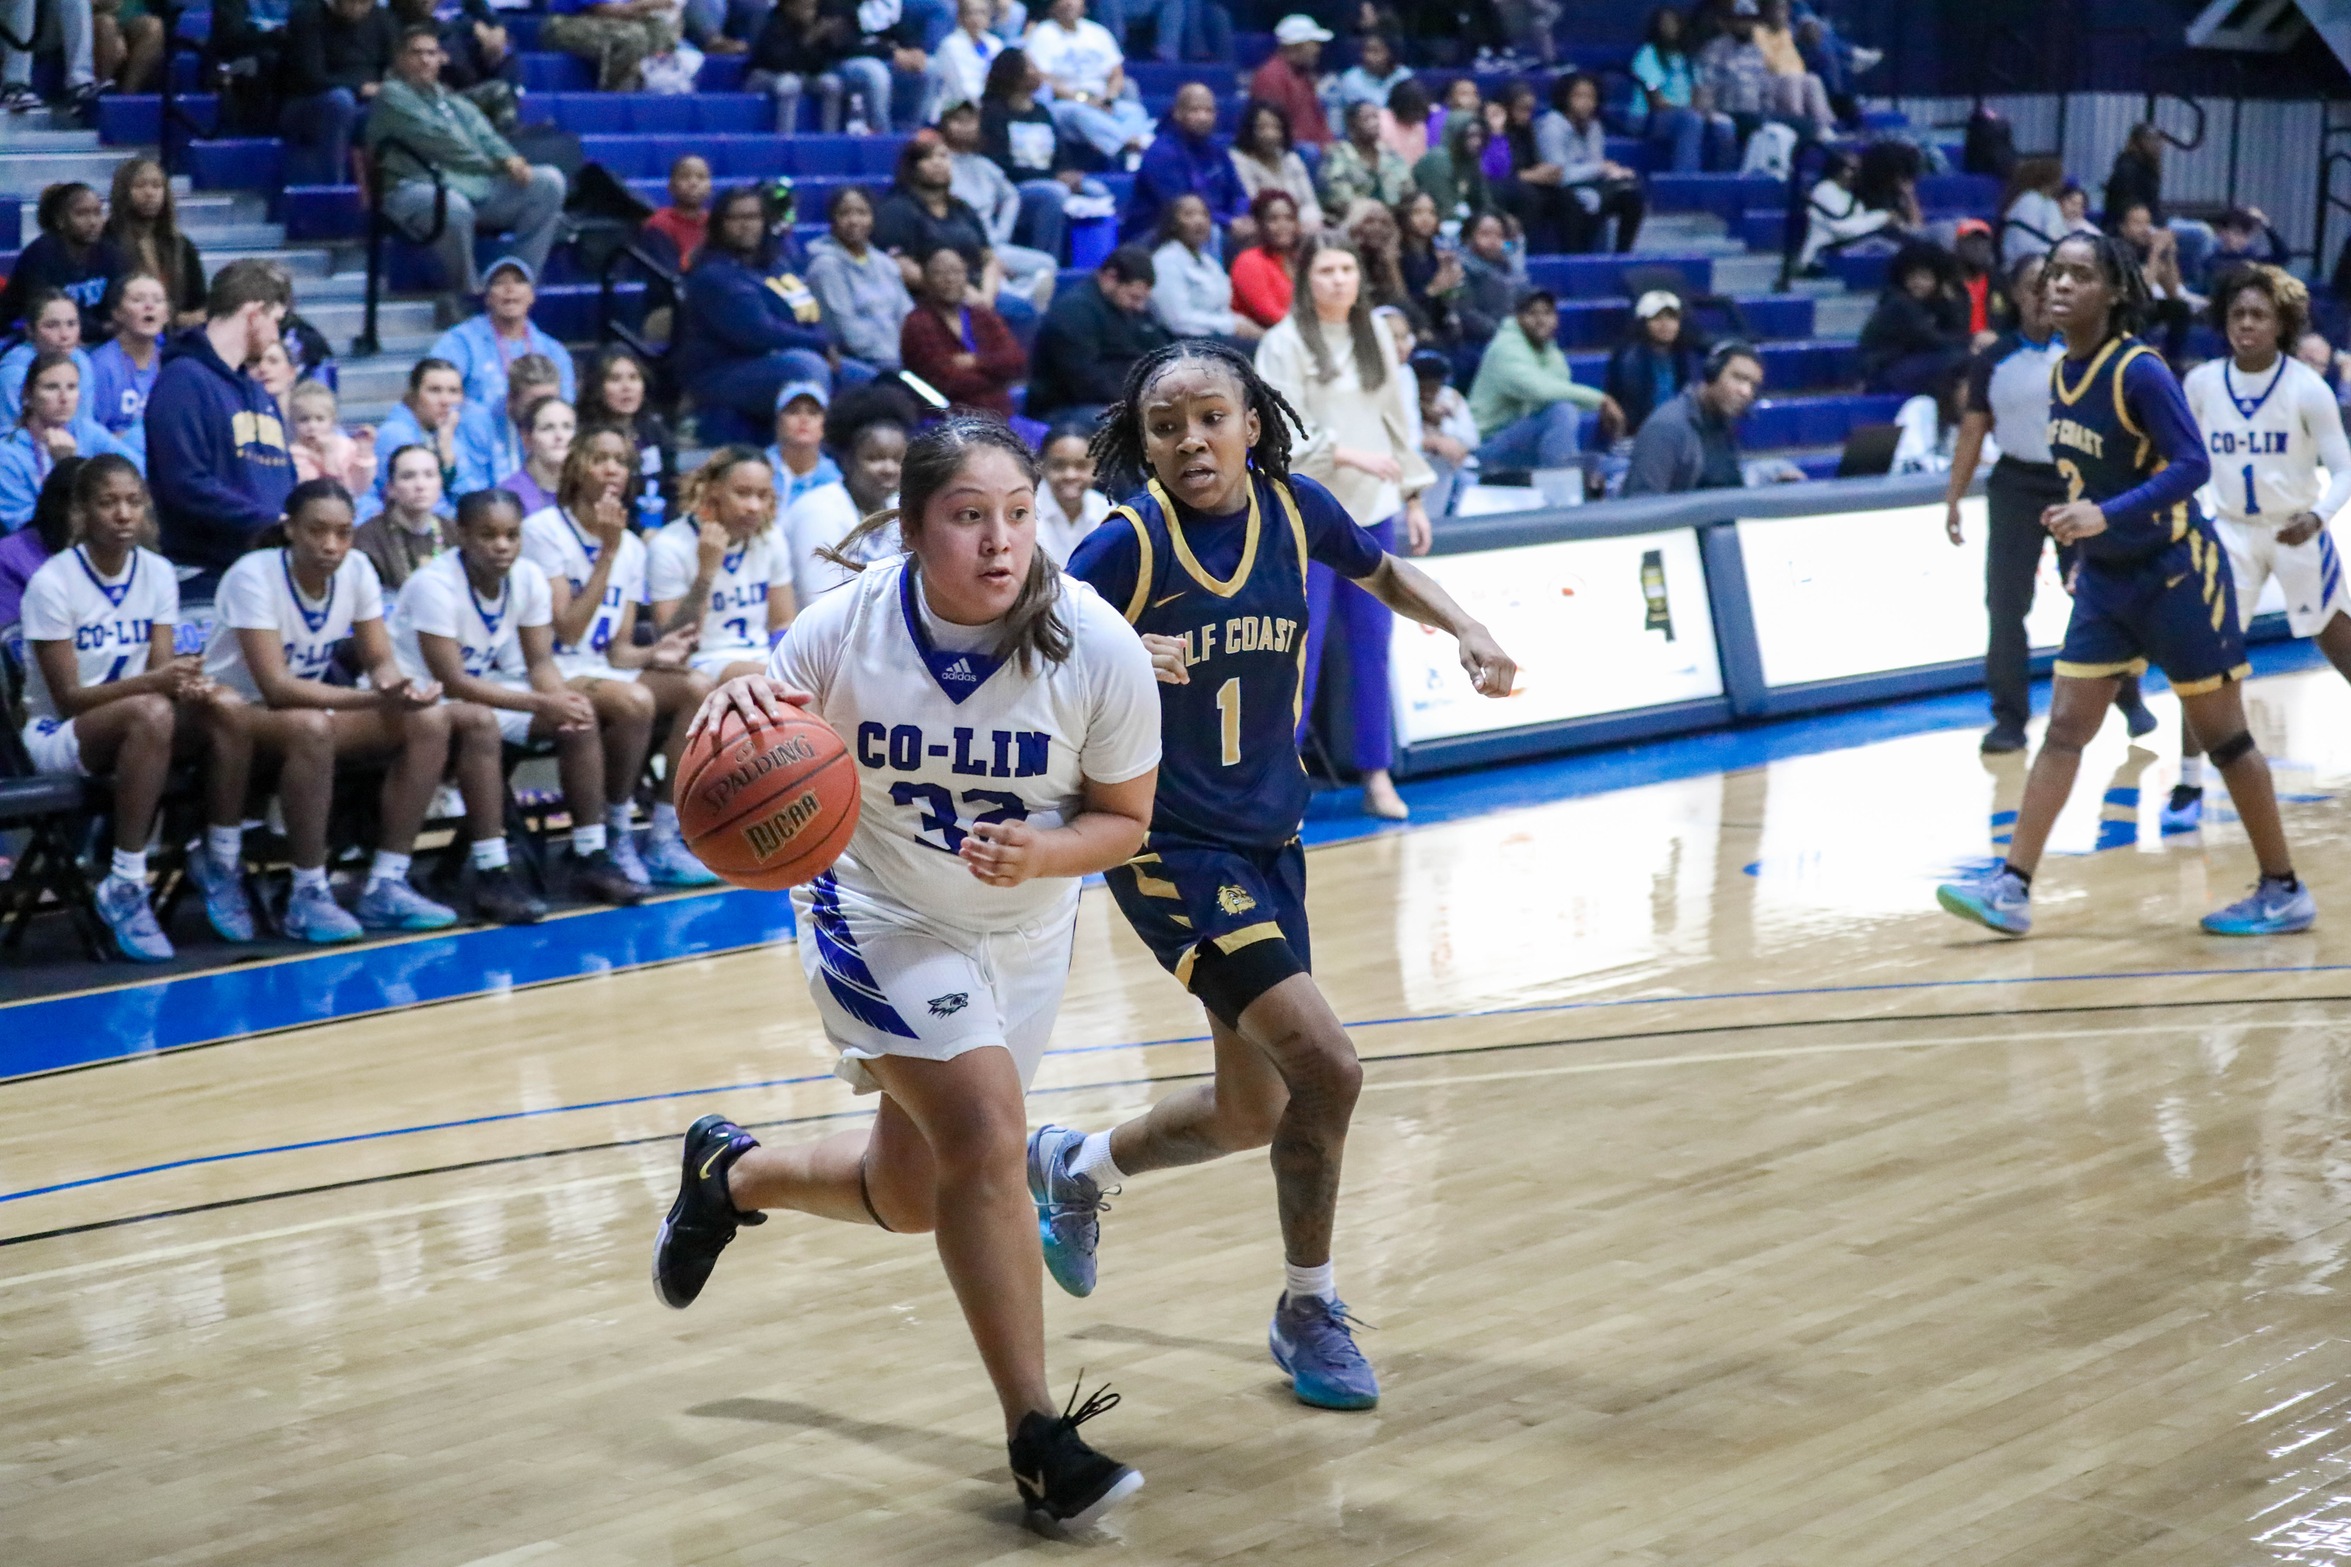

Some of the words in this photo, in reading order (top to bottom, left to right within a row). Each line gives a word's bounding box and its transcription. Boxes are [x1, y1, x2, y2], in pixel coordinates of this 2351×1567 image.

[2211, 431, 2288, 454] CO-LIN
[2242, 464, 2261, 515] 1
[1225, 616, 1298, 654] COAST
[941, 672, 977, 683] adidas
[1216, 677, 1241, 766] 1
[703, 734, 816, 817] SPALDING
[857, 721, 1052, 778] CO-LIN
[742, 790, 822, 863] NJCAA
